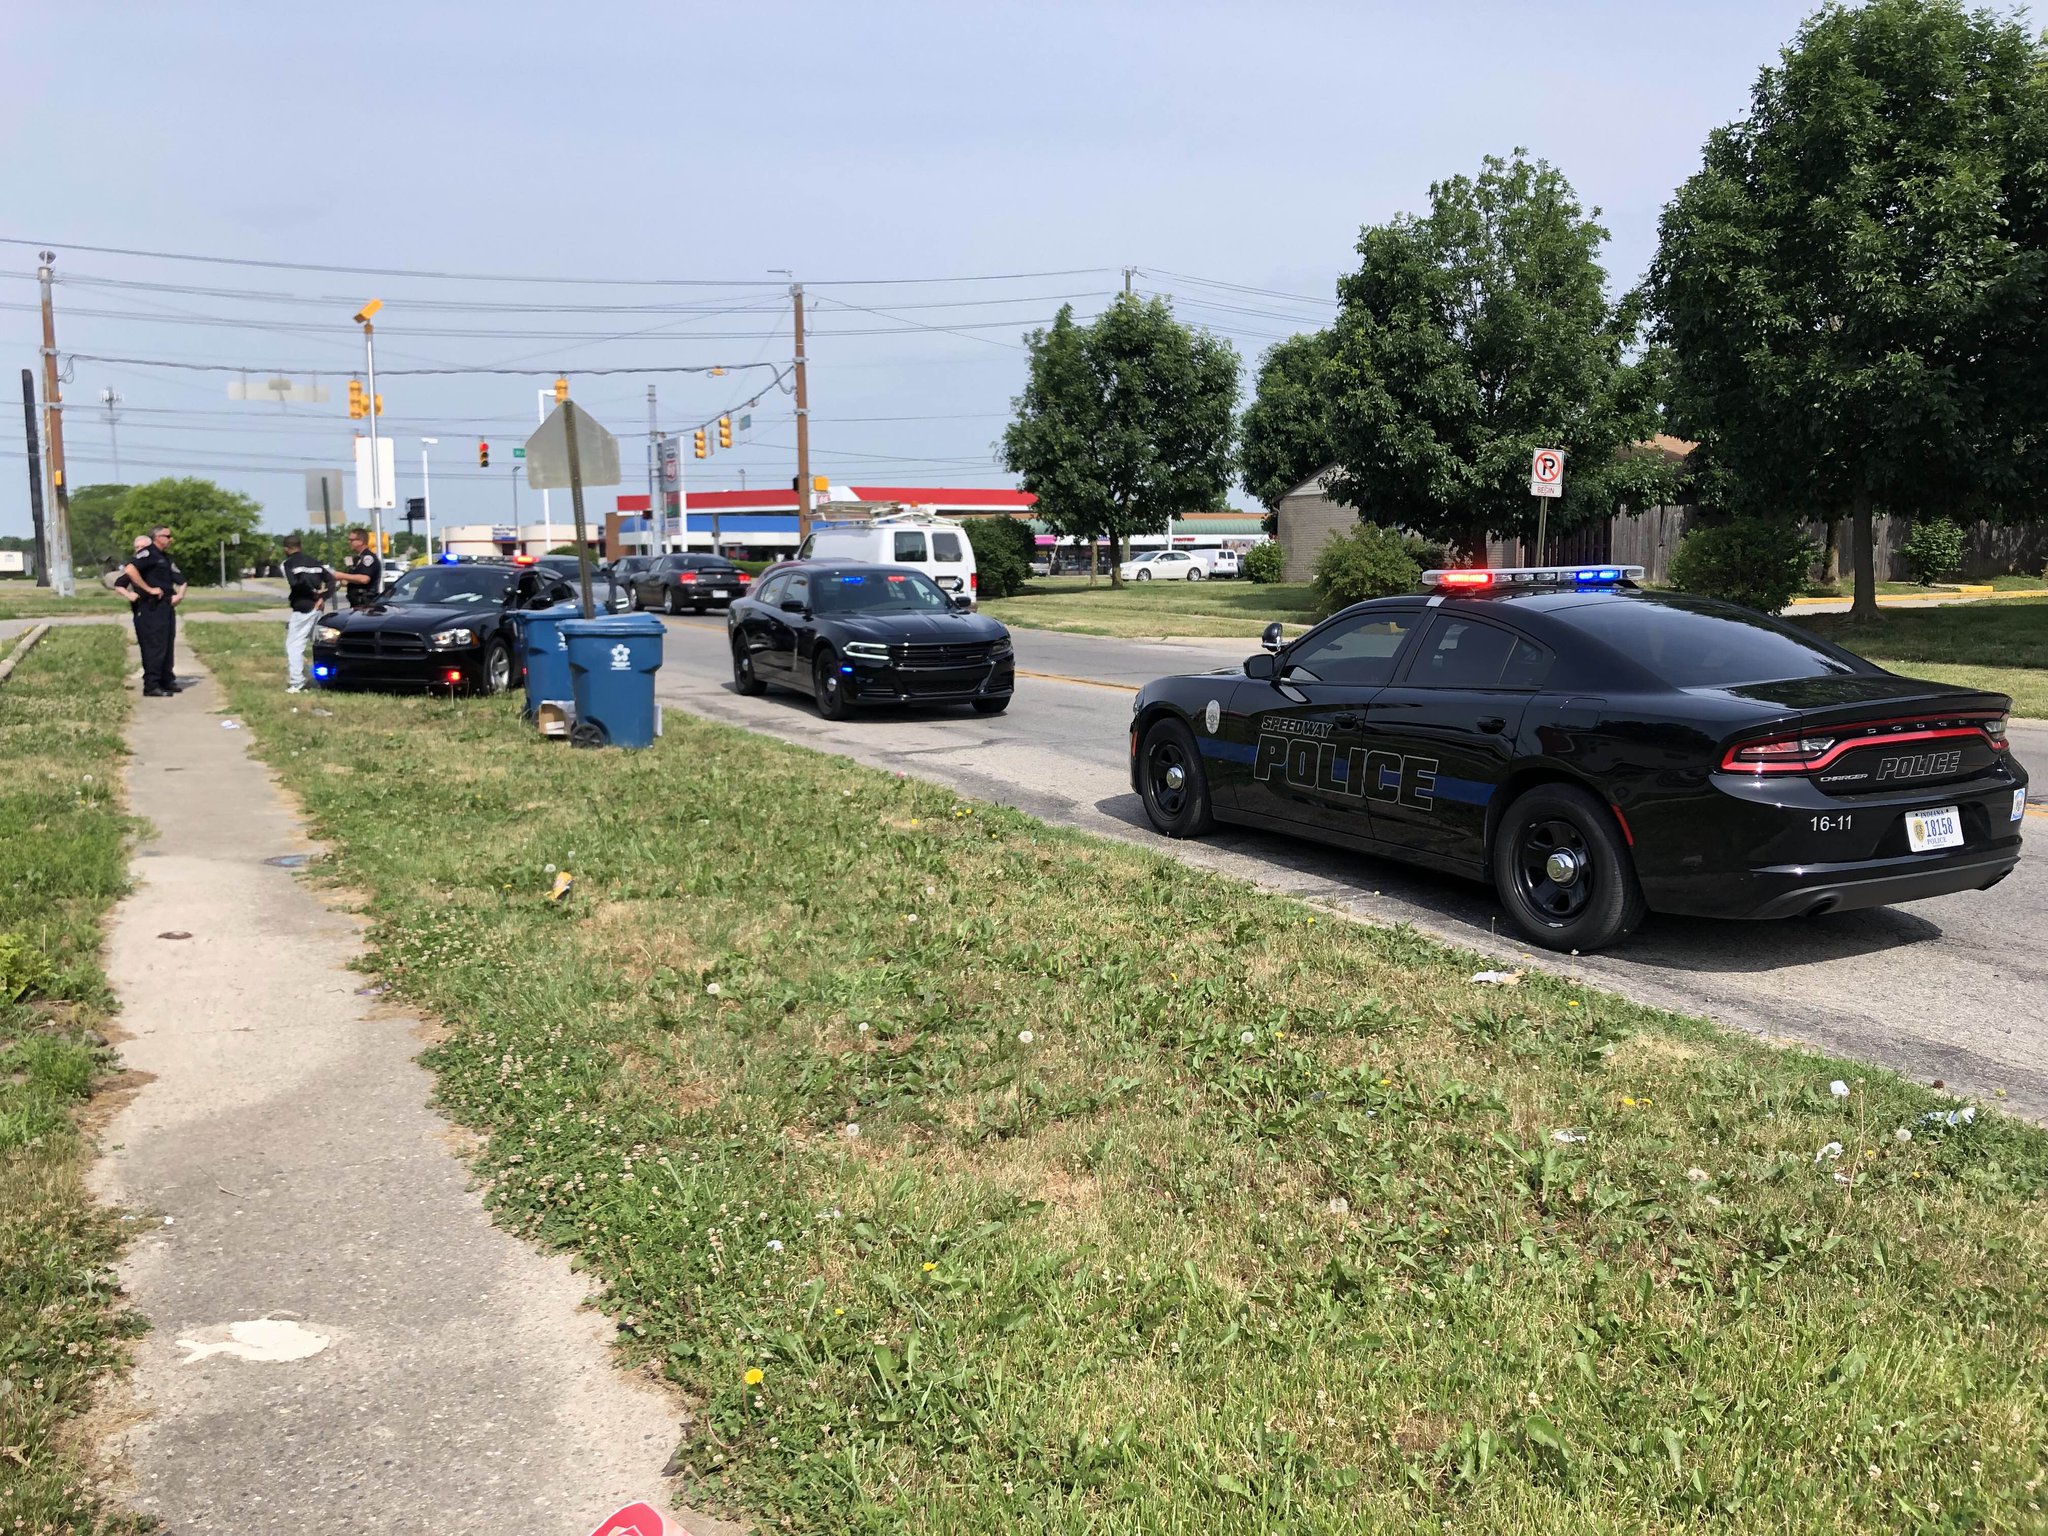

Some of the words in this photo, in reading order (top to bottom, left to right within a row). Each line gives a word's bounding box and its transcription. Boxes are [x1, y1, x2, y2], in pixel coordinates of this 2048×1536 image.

[1261, 715, 1334, 739] SPEEDWAY
[1253, 733, 1439, 812] POLICE
[1875, 750, 1962, 781] POLICE
[1819, 773, 1869, 783] CHARGER
[1810, 815, 1852, 832] 16-11
[1920, 809, 1945, 819] INDIANA
[1924, 816, 1954, 838] 18158
[1926, 836, 1948, 846] POLICE
